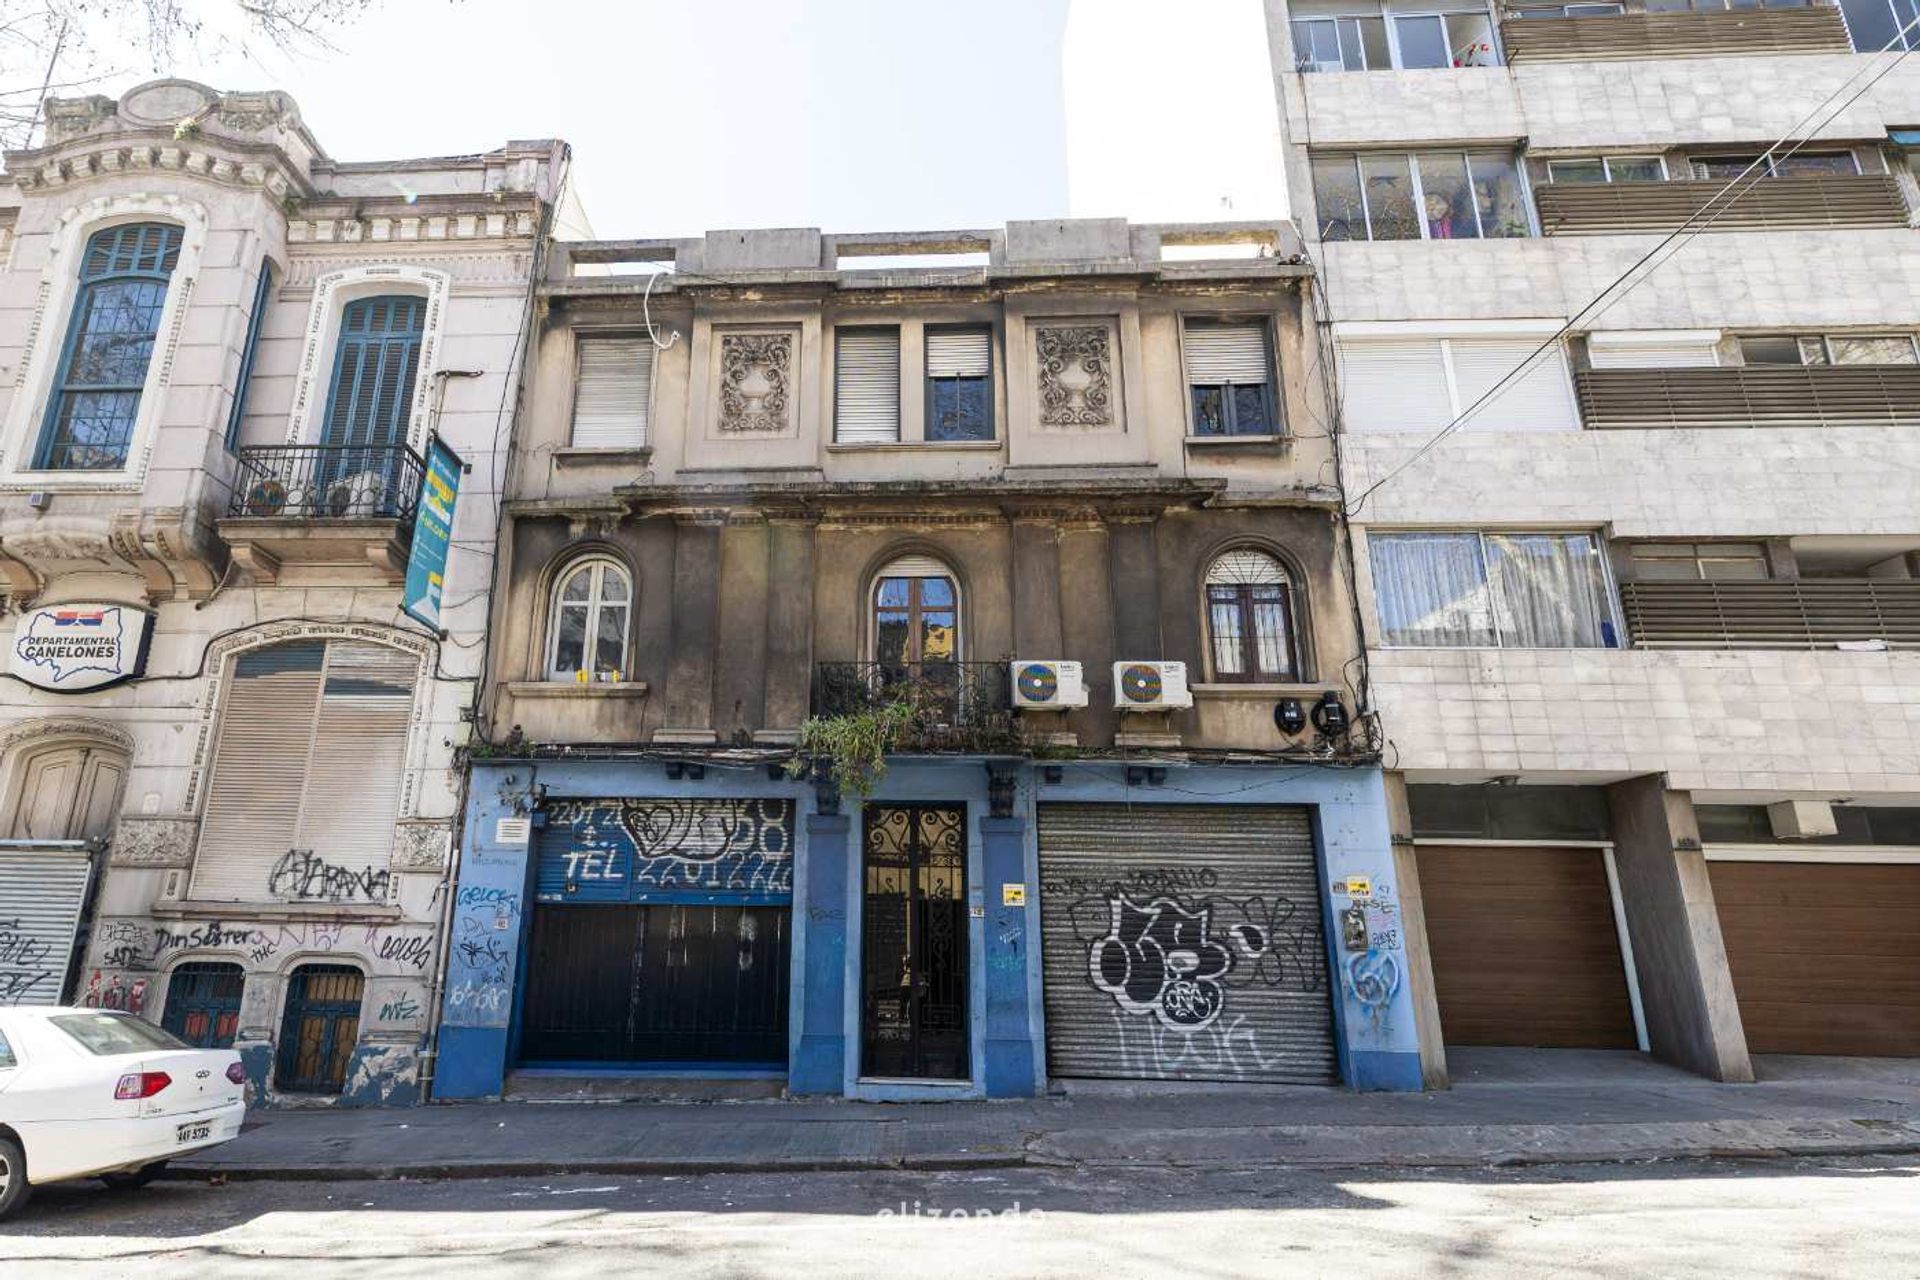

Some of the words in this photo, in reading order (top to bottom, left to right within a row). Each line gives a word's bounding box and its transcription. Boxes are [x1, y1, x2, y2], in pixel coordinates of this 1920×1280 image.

[28, 637, 117, 646] DEPARTAMENTAL
[25, 646, 116, 658] CANELONES
[562, 850, 624, 880] TEL
